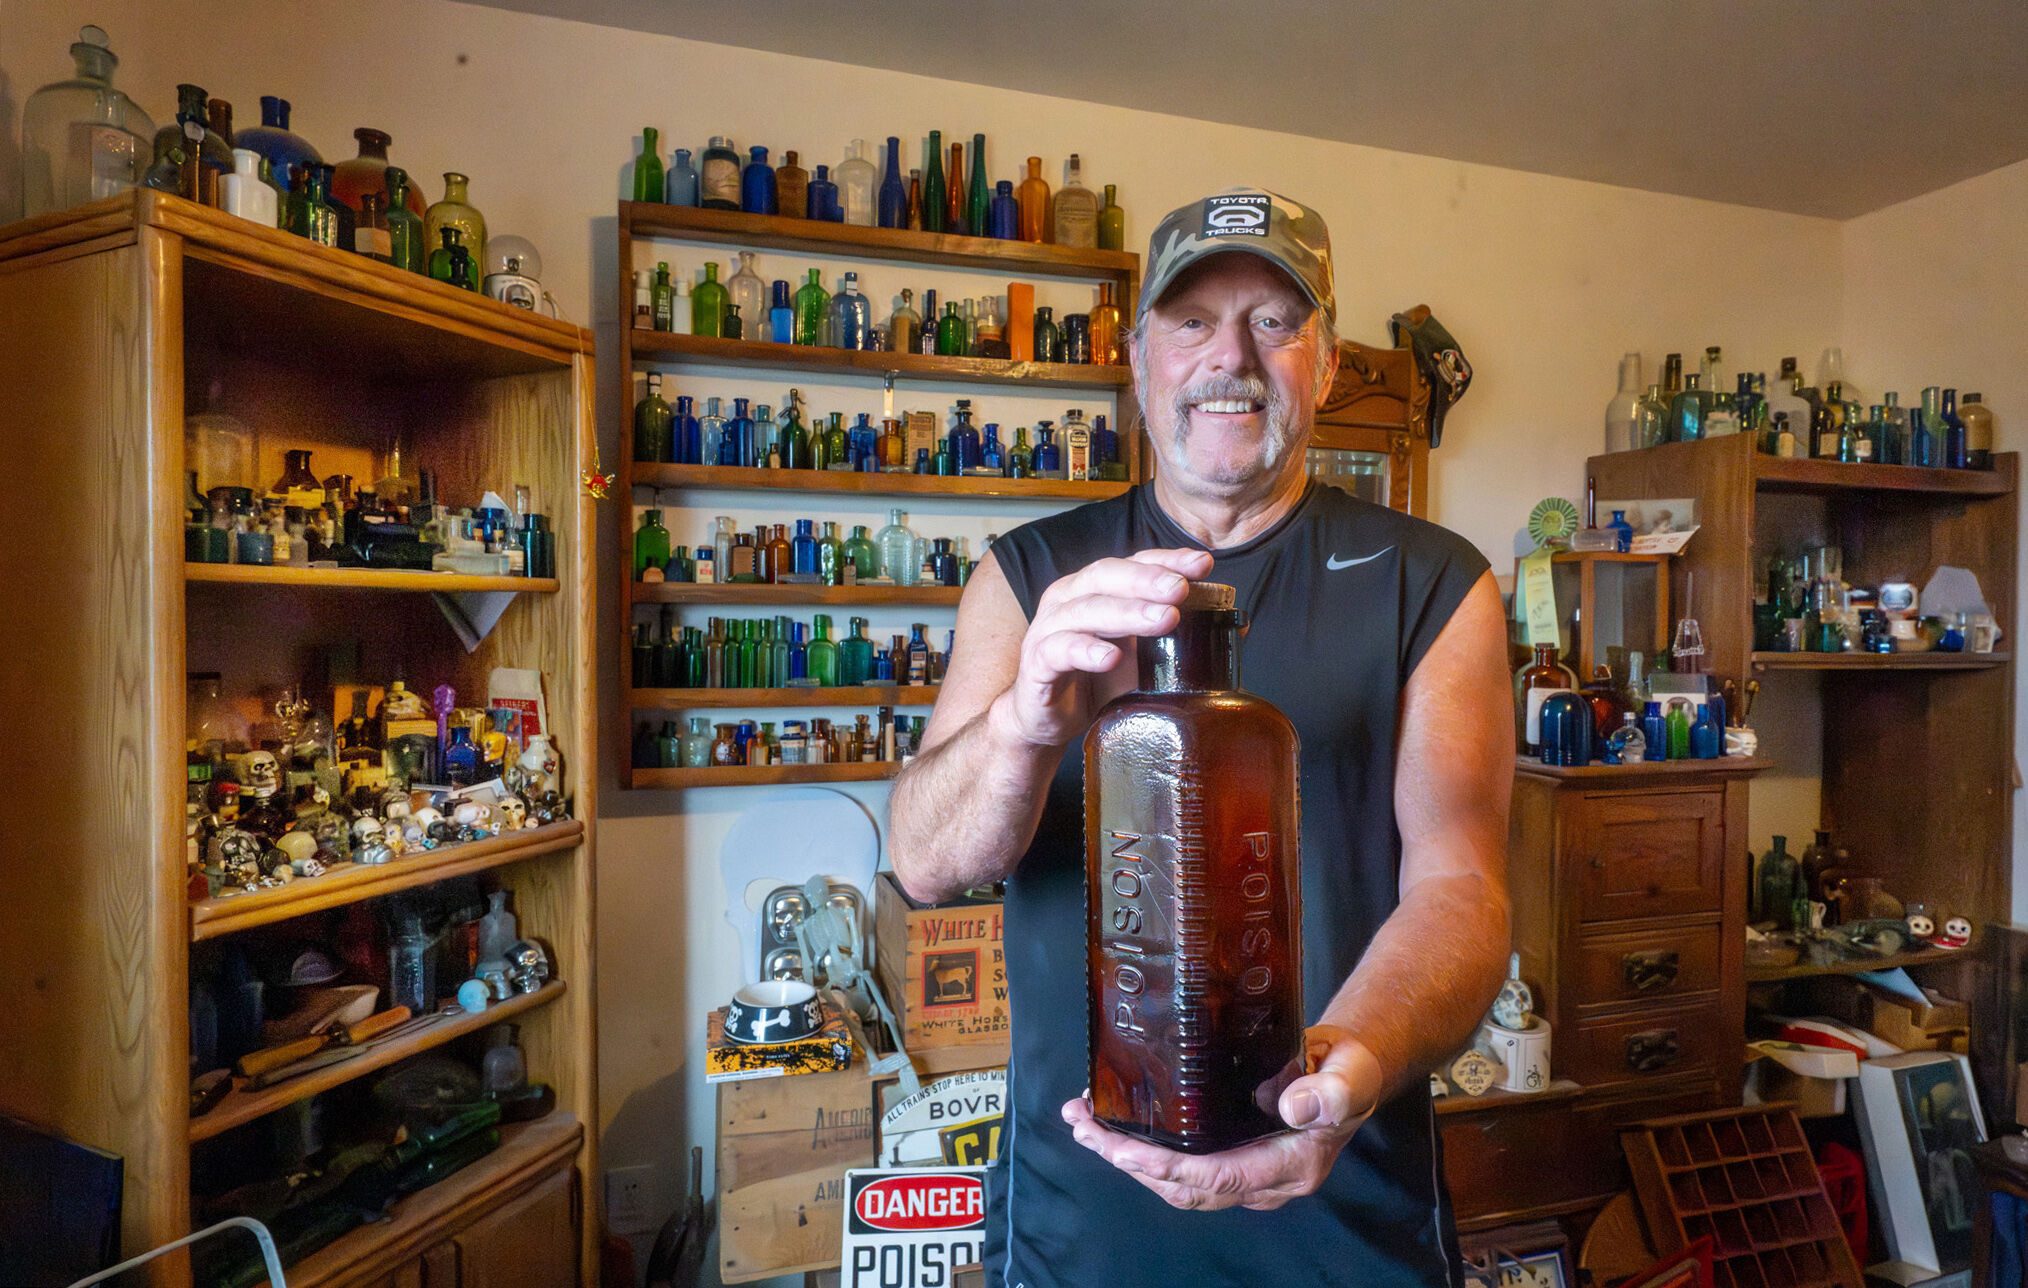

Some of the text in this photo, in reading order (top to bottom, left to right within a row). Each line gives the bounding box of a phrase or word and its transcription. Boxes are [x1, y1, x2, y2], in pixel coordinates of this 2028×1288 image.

[1211, 197, 1267, 205] TOYOTA
[1206, 227, 1265, 236] TRUCKS
[920, 918, 986, 946] WHITE
[1111, 830, 1144, 1036] POISON
[1241, 831, 1272, 1037] POISON
[922, 1019, 963, 1030] WHITE
[886, 1107, 903, 1124] ALL
[902, 1089, 931, 1110] TRAINS
[932, 1078, 952, 1094] STOP
[954, 1072, 977, 1086] HERE
[929, 1094, 1000, 1120] BOVR
[864, 1186, 985, 1219] DANGER
